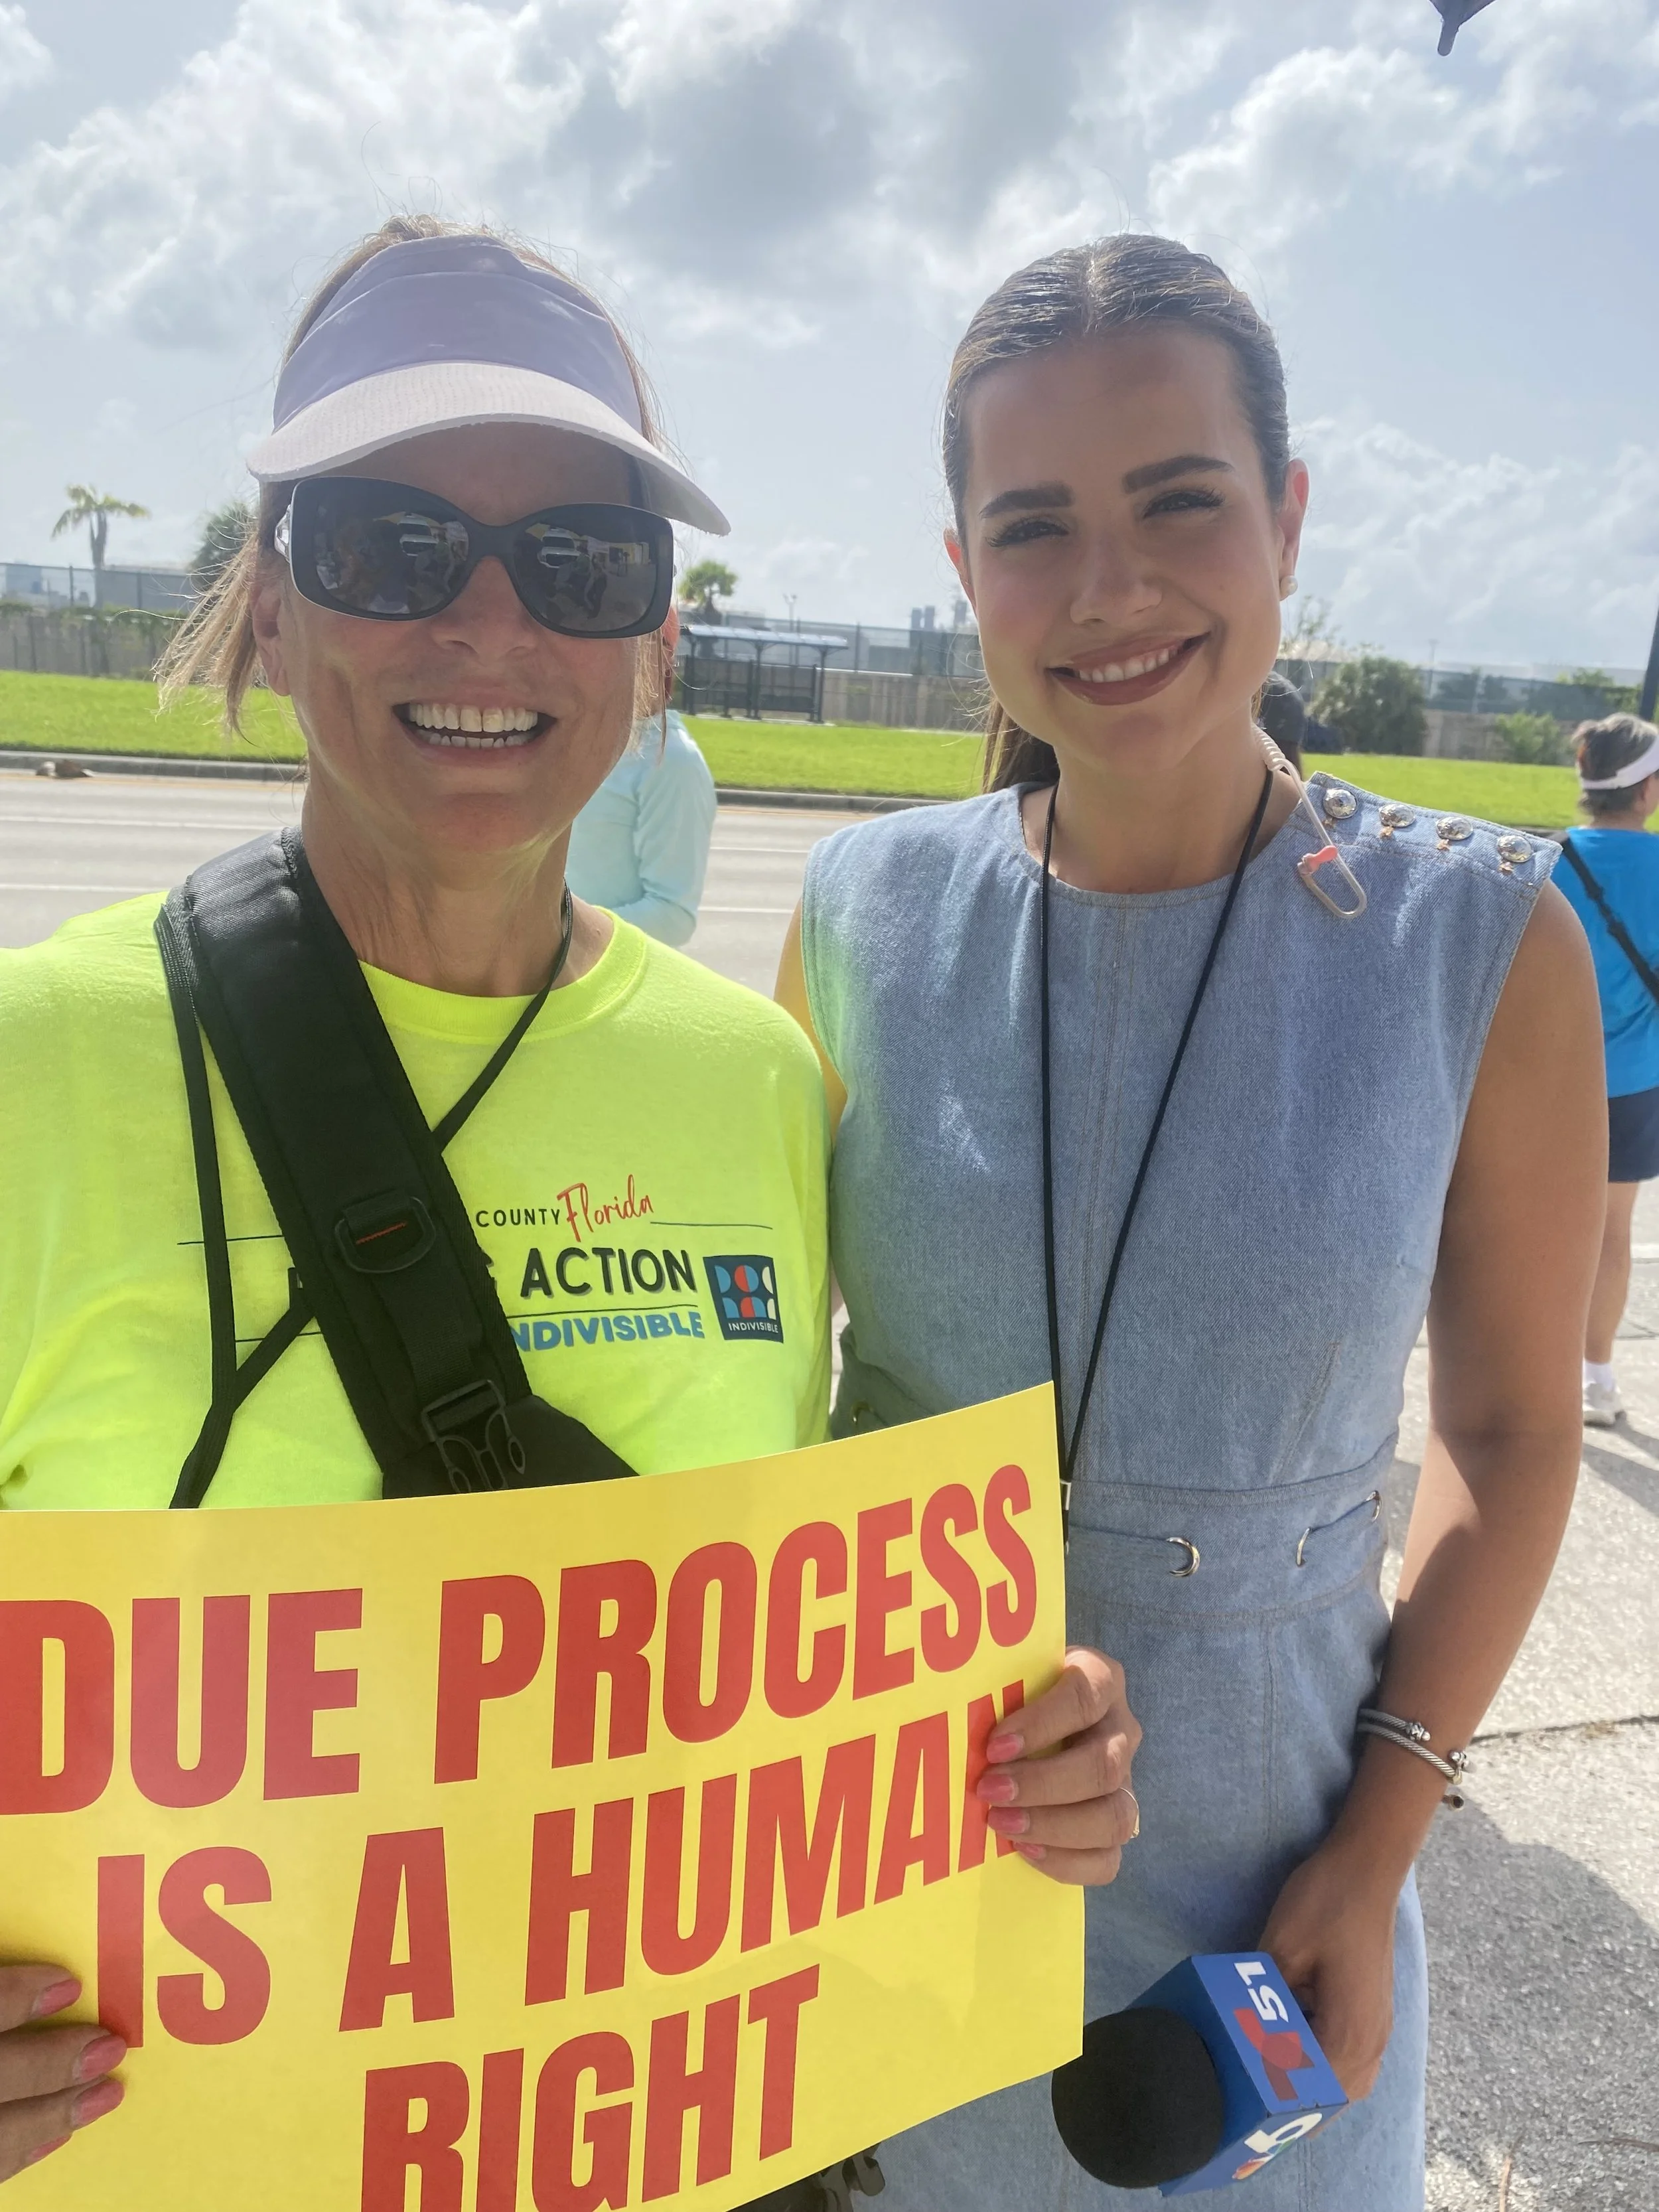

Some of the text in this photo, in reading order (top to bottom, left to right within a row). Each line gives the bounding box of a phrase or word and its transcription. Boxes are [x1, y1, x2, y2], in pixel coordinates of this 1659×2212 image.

[476, 1173, 654, 1243] COUNTY Florida
[520, 1246, 697, 1297] ACTION
[508, 1311, 705, 1352] NDIVISIBLE
[728, 1321, 779, 1333] INDIVISIBLE
[0, 1464, 1037, 1815] DUE PROCESS
[97, 1846, 272, 2049] IS
[338, 1826, 455, 2032] A
[1234, 1961, 1289, 2023] 51
[361, 1963, 820, 2212] RIGHT
